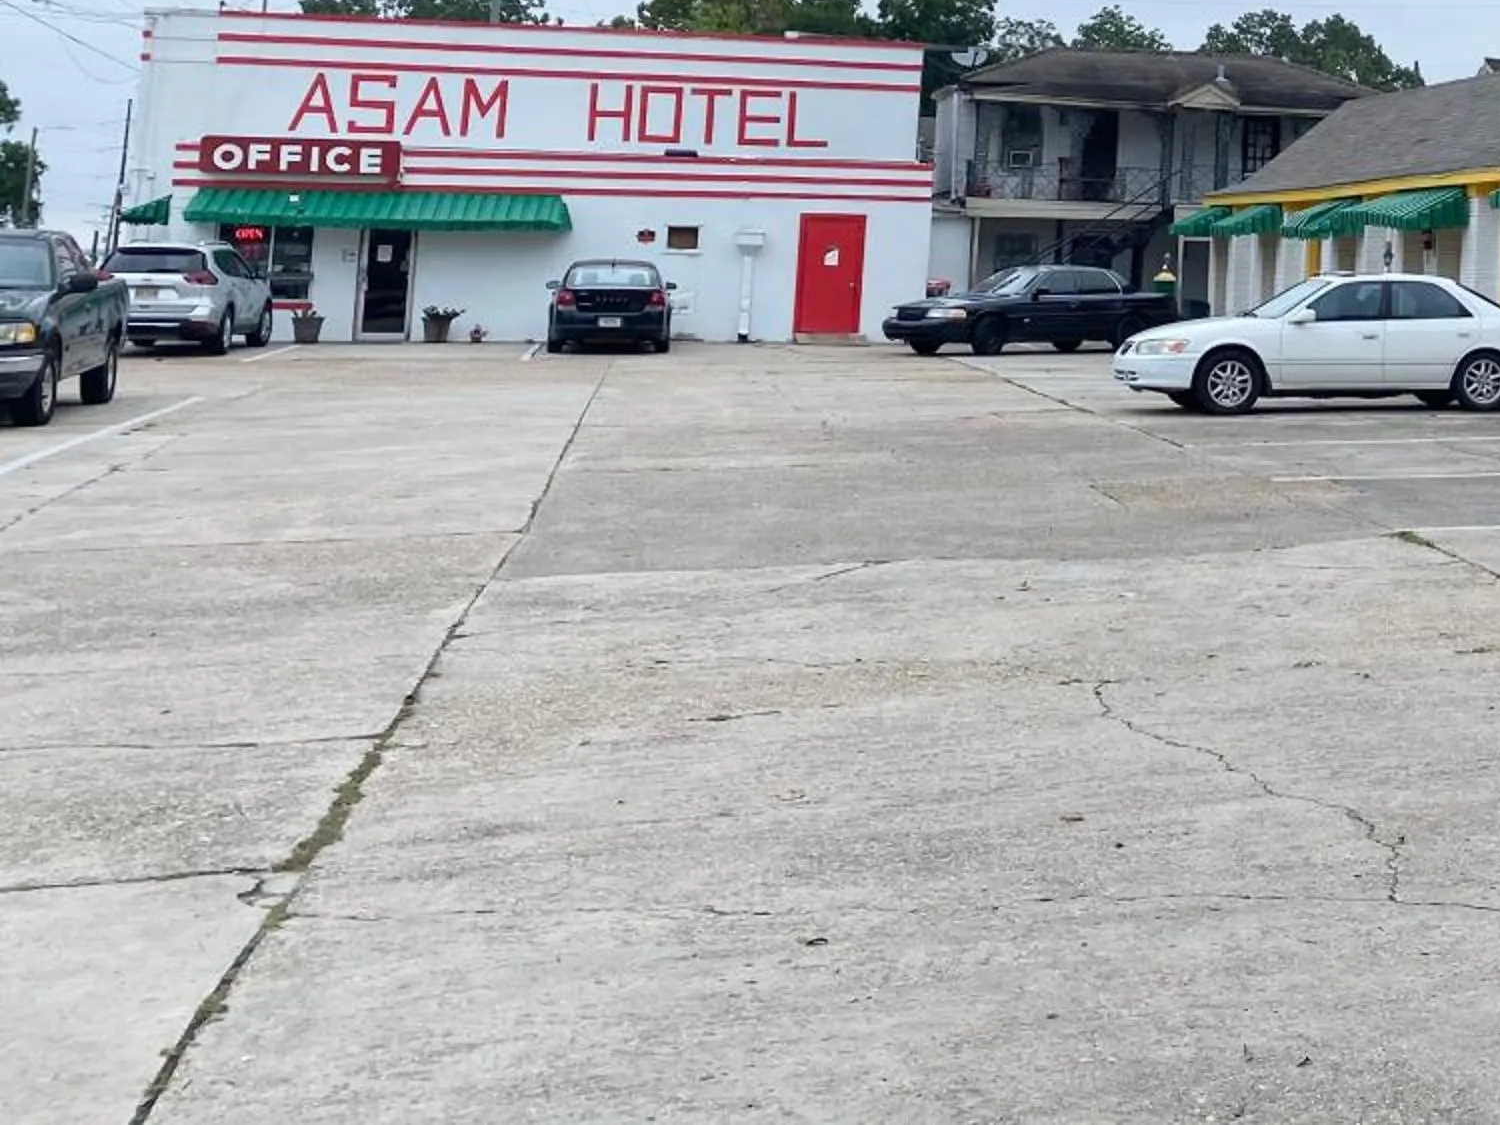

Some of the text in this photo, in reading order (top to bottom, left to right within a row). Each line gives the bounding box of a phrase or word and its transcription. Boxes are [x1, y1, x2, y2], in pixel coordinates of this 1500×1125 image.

[288, 72, 829, 148] ASAM HOTEL
[212, 142, 383, 174] OFFICE
